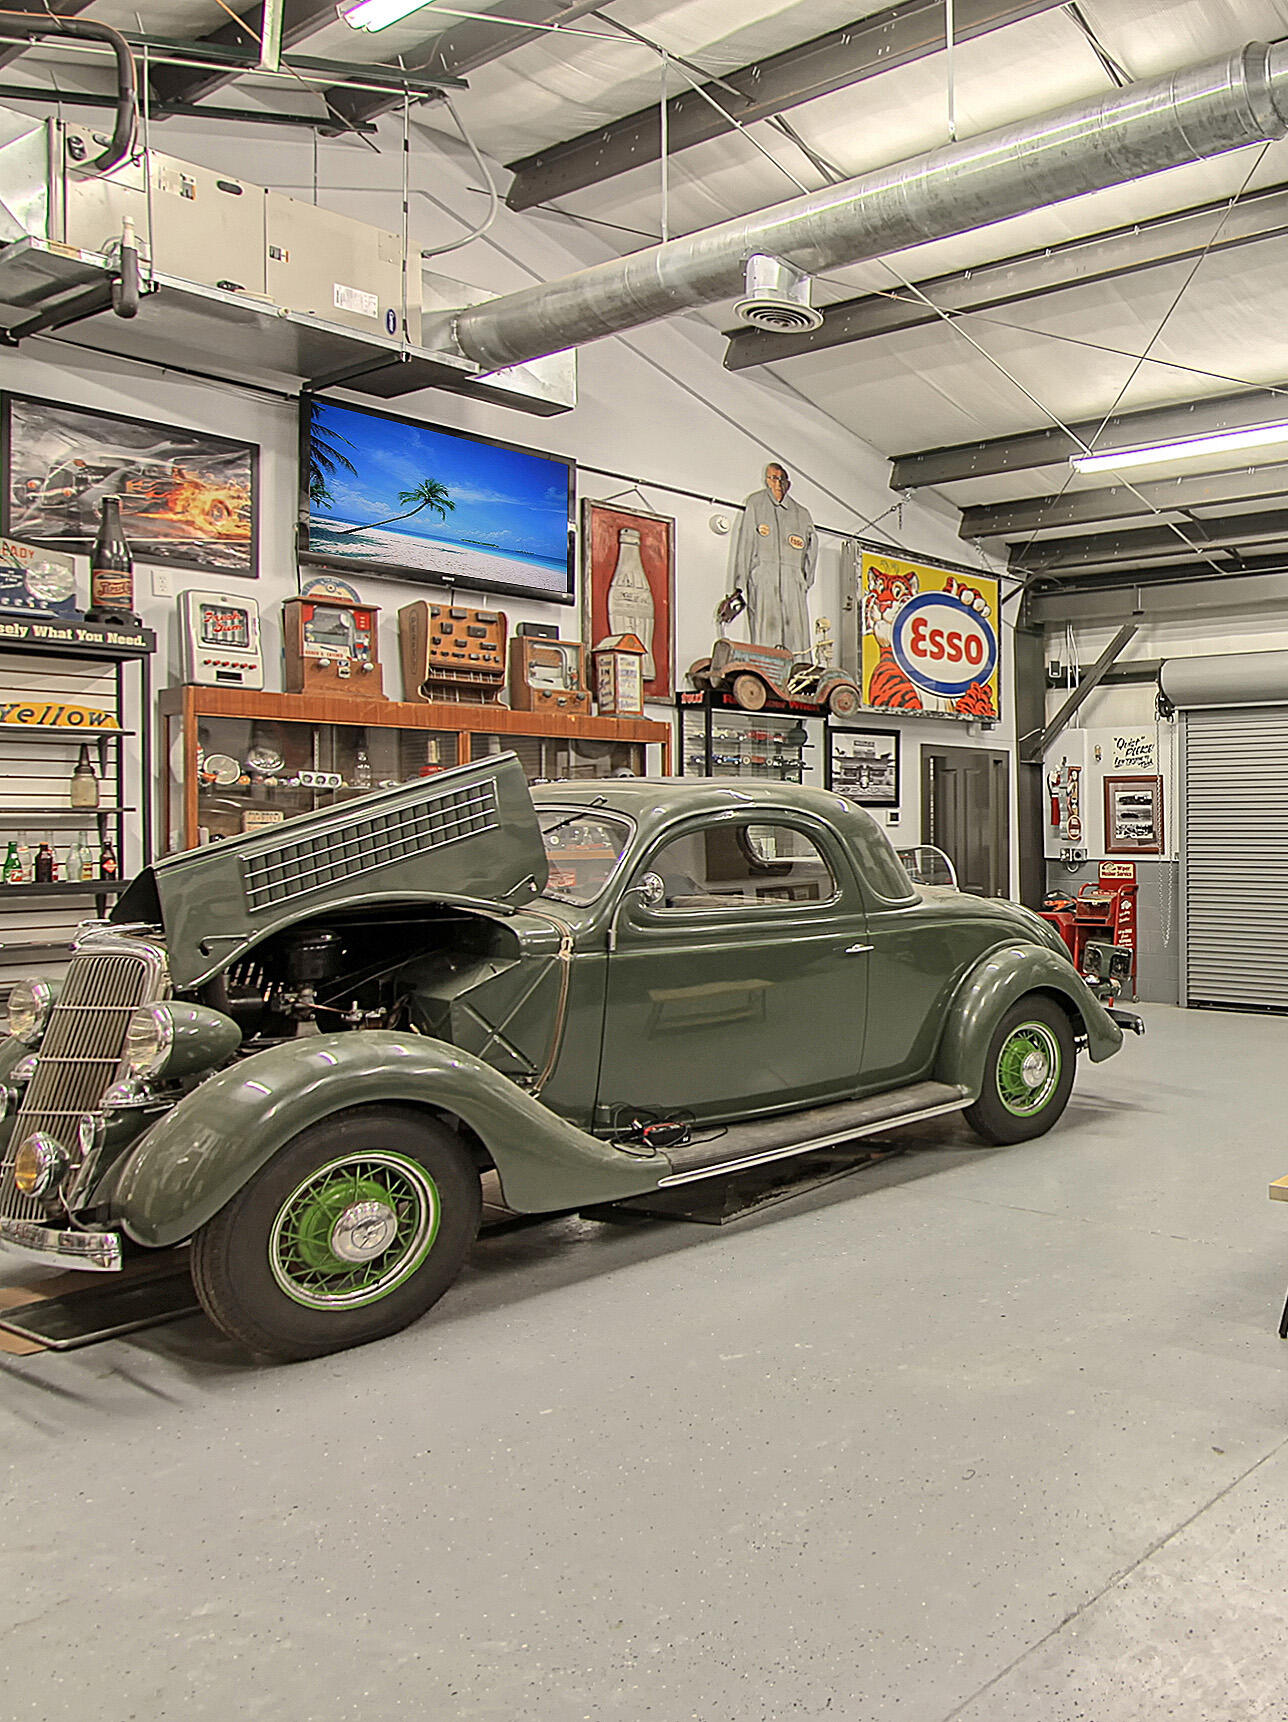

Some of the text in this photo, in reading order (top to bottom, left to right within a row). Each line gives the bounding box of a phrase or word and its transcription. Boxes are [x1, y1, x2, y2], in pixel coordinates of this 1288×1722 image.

[0, 542, 35, 560] EADY
[32, 625, 73, 640] What
[76, 629, 103, 643] You
[107, 632, 147, 647] Need.
[0, 704, 111, 726] Yellow
